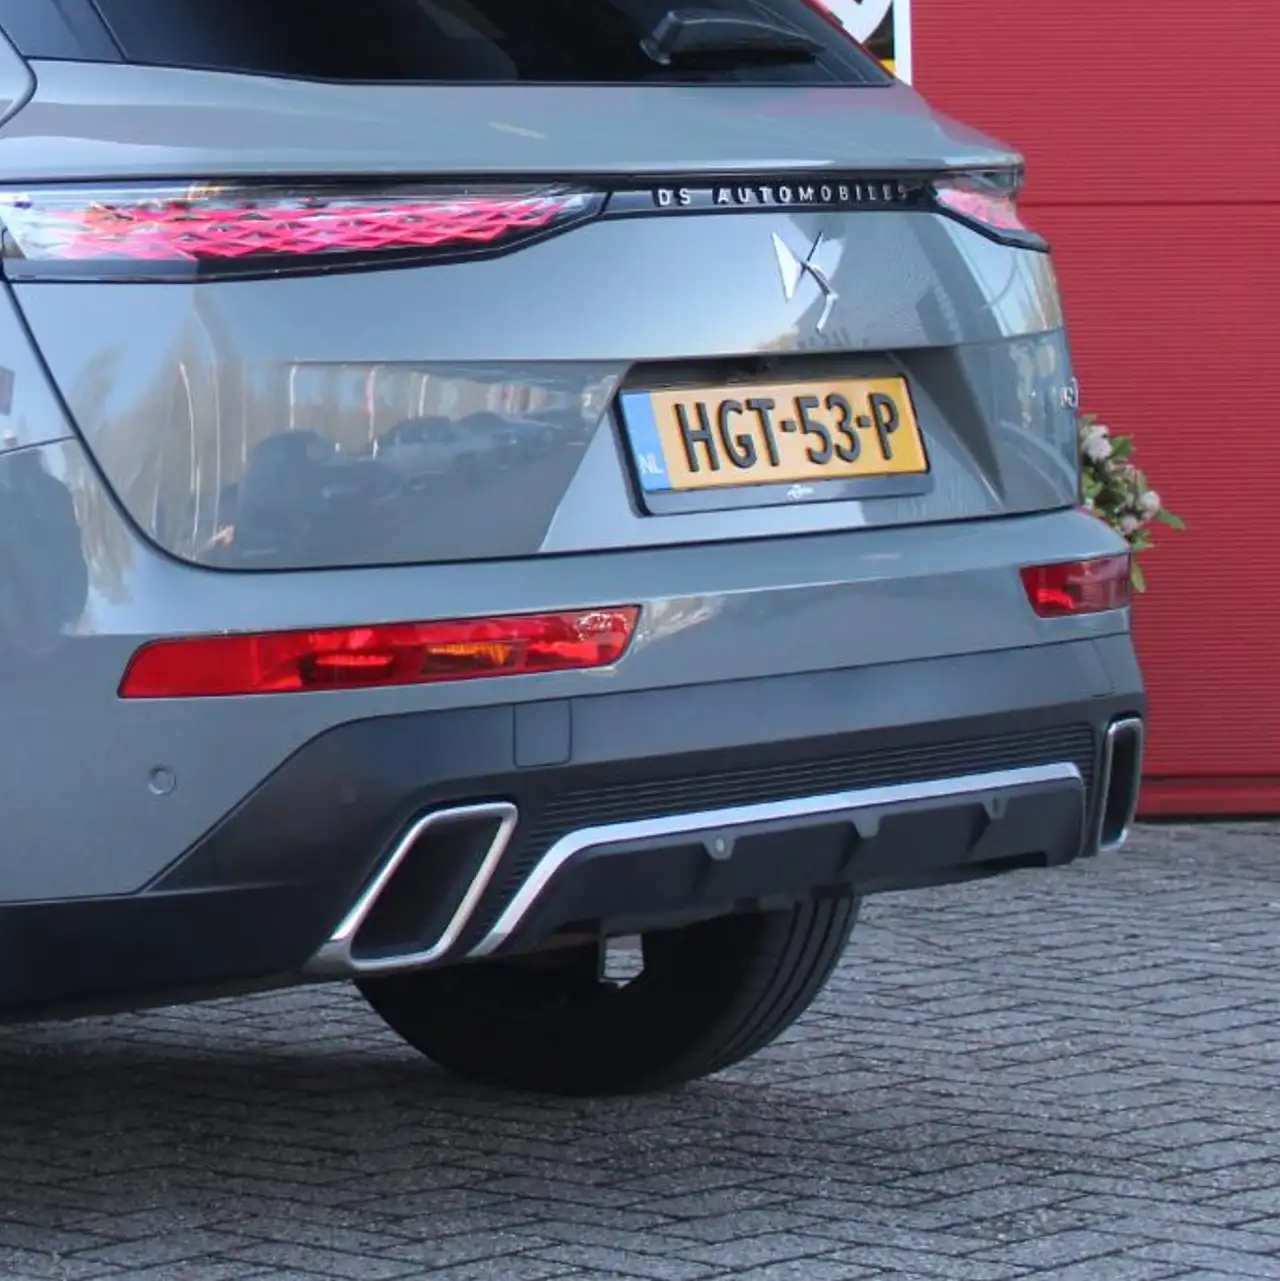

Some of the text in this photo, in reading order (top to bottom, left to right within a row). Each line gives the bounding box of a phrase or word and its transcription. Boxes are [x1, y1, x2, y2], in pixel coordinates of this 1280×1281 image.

[657, 184, 908, 206] DS AUTOMOBILES
[674, 392, 900, 473] HGT-53-P
[639, 452, 665, 474] NL
